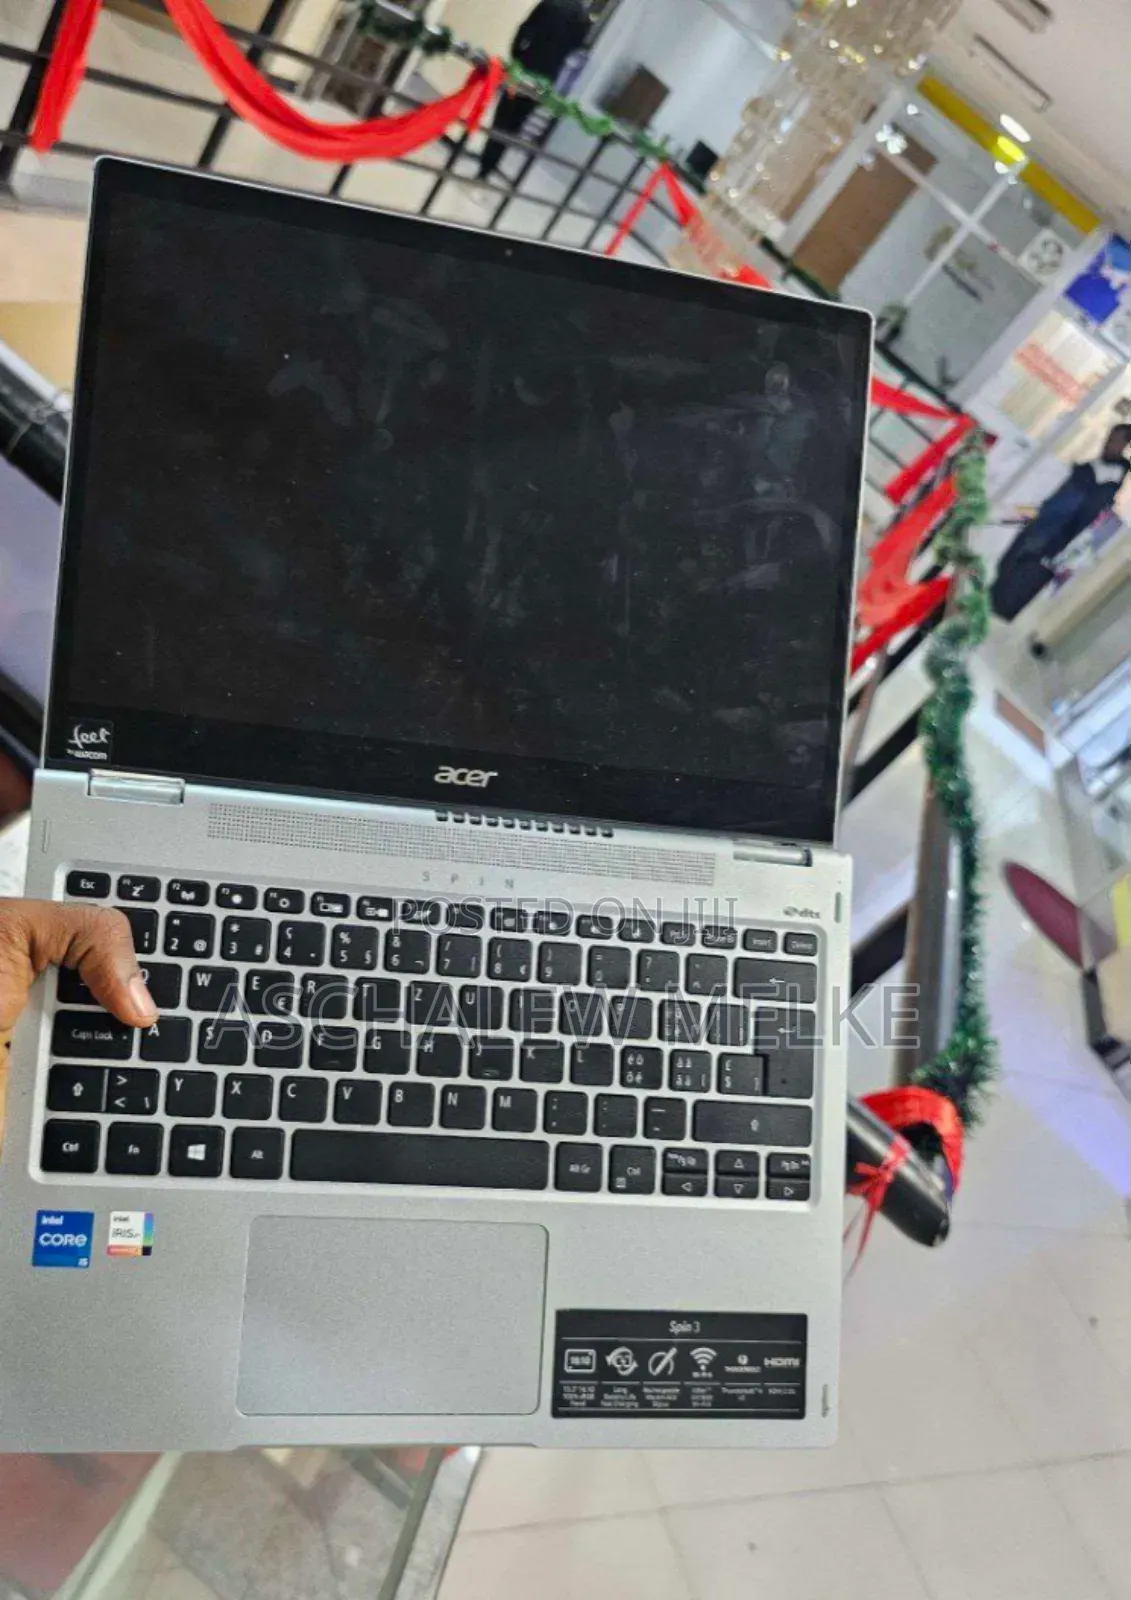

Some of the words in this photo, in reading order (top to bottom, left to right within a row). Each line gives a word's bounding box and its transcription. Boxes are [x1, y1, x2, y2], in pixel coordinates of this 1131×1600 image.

[434, 765, 498, 787] acer
[80, 878, 95, 890] Esc
[170, 938, 178, 950] 2
[229, 942, 237, 955] 3
[283, 946, 292, 958] 4
[340, 949, 348, 962] 5
[391, 954, 399, 967] 6
[443, 958, 450, 970] 7
[494, 962, 501, 974] 8
[196, 972, 212, 987] W
[252, 976, 260, 990] E
[307, 979, 316, 993] R
[361, 984, 370, 997] T
[415, 988, 422, 1001] Z
[464, 991, 475, 1005] U
[72, 1028, 92, 1041] Caps
[94, 1031, 113, 1041] Lock
[148, 1022, 160, 1037] A
[205, 1026, 214, 1040] S
[261, 1030, 272, 1044] D
[372, 1036, 381, 1050] G
[424, 1040, 434, 1053] H
[476, 1043, 483, 1055] J
[526, 1046, 535, 1059] K
[577, 1049, 584, 1063] L
[174, 1078, 184, 1092] Y
[231, 1081, 242, 1095] X
[286, 1083, 297, 1098] C
[342, 1086, 353, 1100] V
[395, 1089, 404, 1102] B
[447, 1092, 458, 1106] N
[500, 1095, 511, 1108] M
[62, 1142, 79, 1152] Ctrl
[128, 1144, 140, 1154] Fn
[252, 1150, 263, 1159] Alt
[669, 1320, 692, 1336] Spin
[693, 1321, 700, 1334] 3
